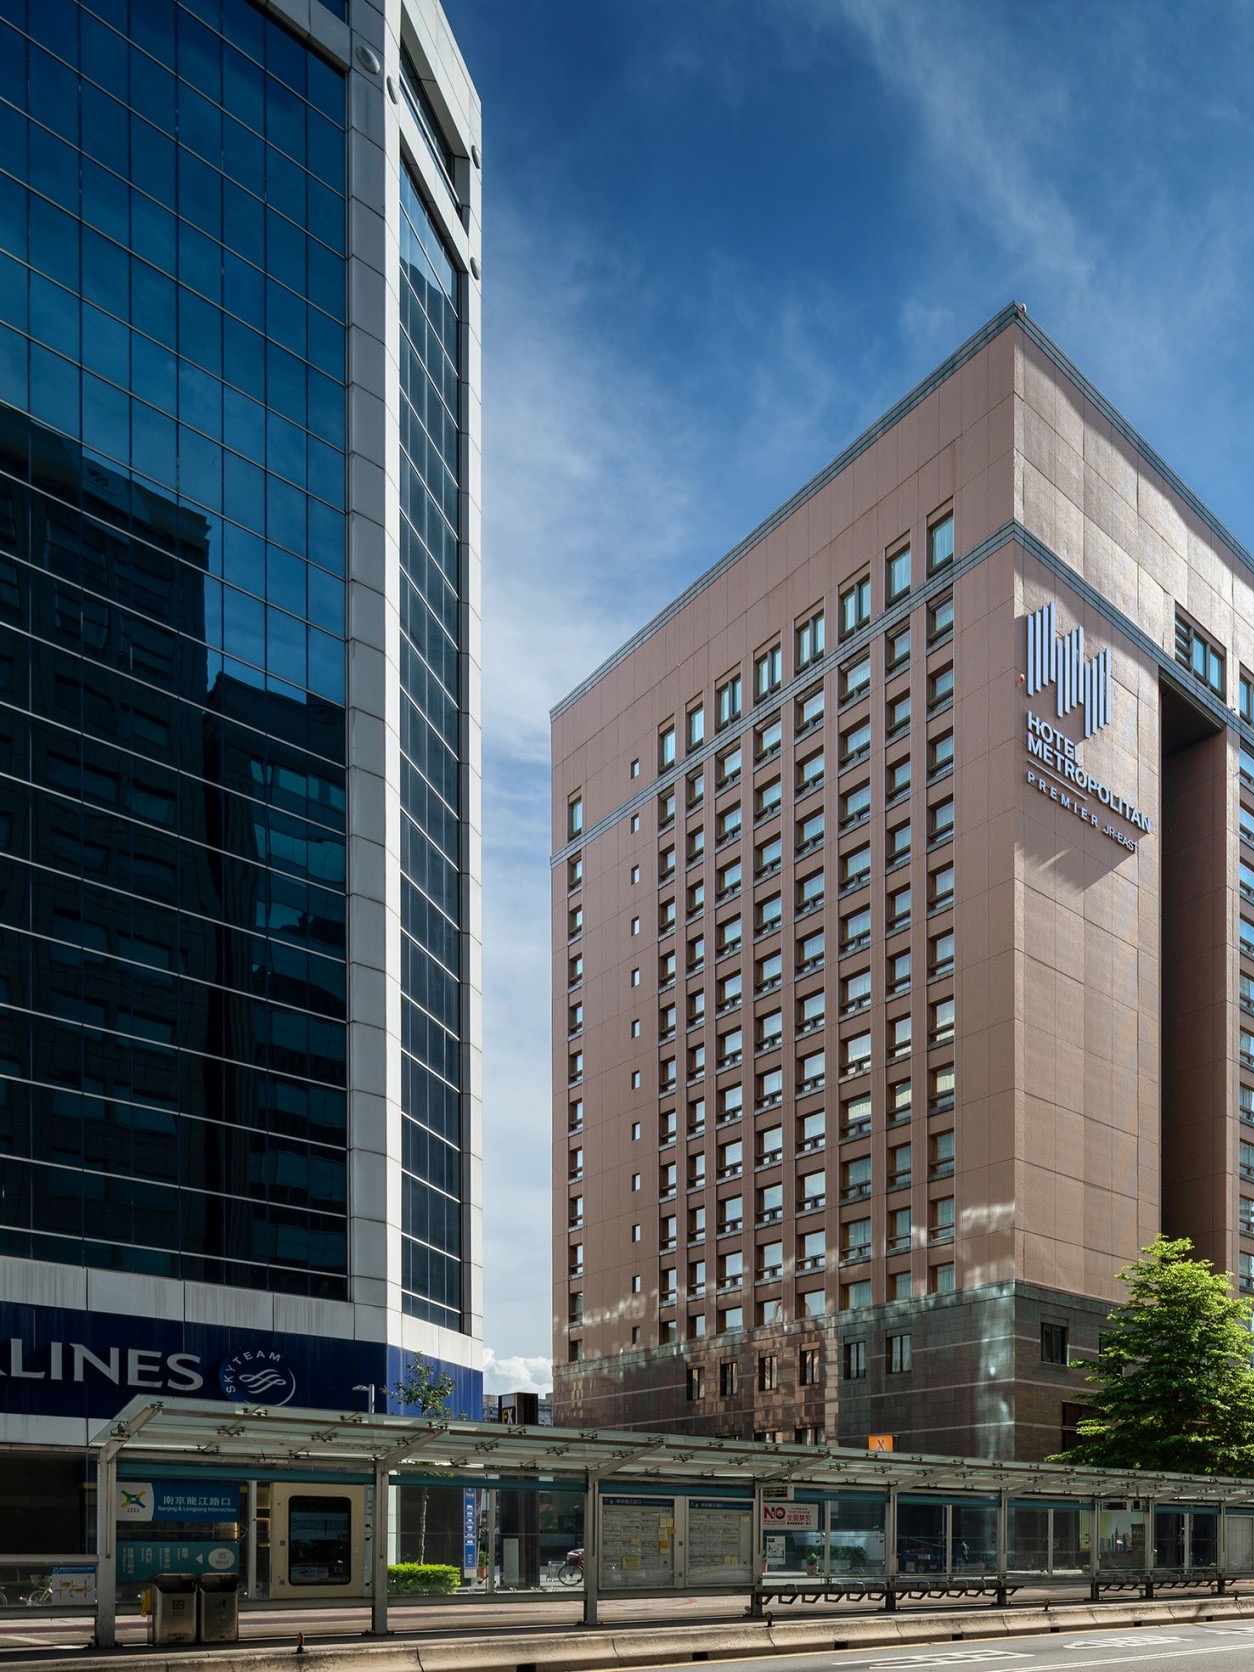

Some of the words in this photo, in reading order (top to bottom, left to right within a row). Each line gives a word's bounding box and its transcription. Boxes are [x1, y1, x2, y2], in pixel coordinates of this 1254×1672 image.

[1027, 710, 1084, 766] HOTEL
[1027, 734, 1151, 835] METROPOLITAN
[1027, 770, 1098, 828] PREMIER
[1103, 824, 1140, 854] JR-EAST
[0, 1338, 204, 1391] LINES
[225, 1350, 281, 1394] SKYTEAM
[158, 1505, 178, 1513] Nanjing
[764, 1506, 786, 1520] NO
